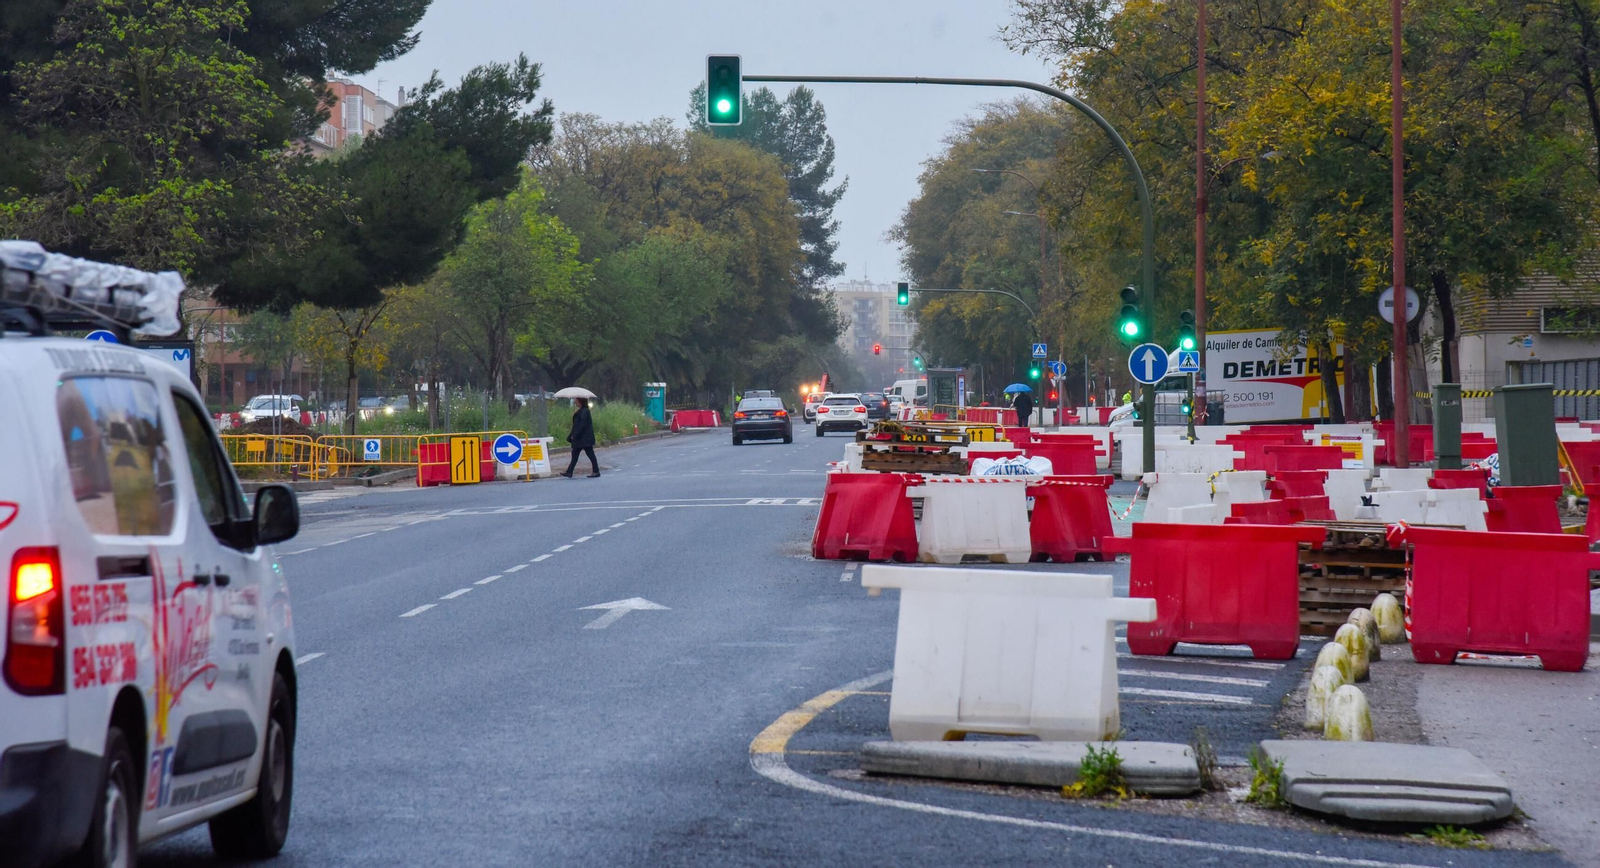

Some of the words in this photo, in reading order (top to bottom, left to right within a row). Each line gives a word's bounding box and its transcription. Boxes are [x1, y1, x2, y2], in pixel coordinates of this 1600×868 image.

[1206, 338, 1240, 353] Alquiler
[1242, 338, 1253, 349] de
[1255, 336, 1283, 349] Camio
[1222, 355, 1345, 379] DEMETRO
[1233, 391, 1255, 402] 500
[1257, 390, 1274, 401] 191
